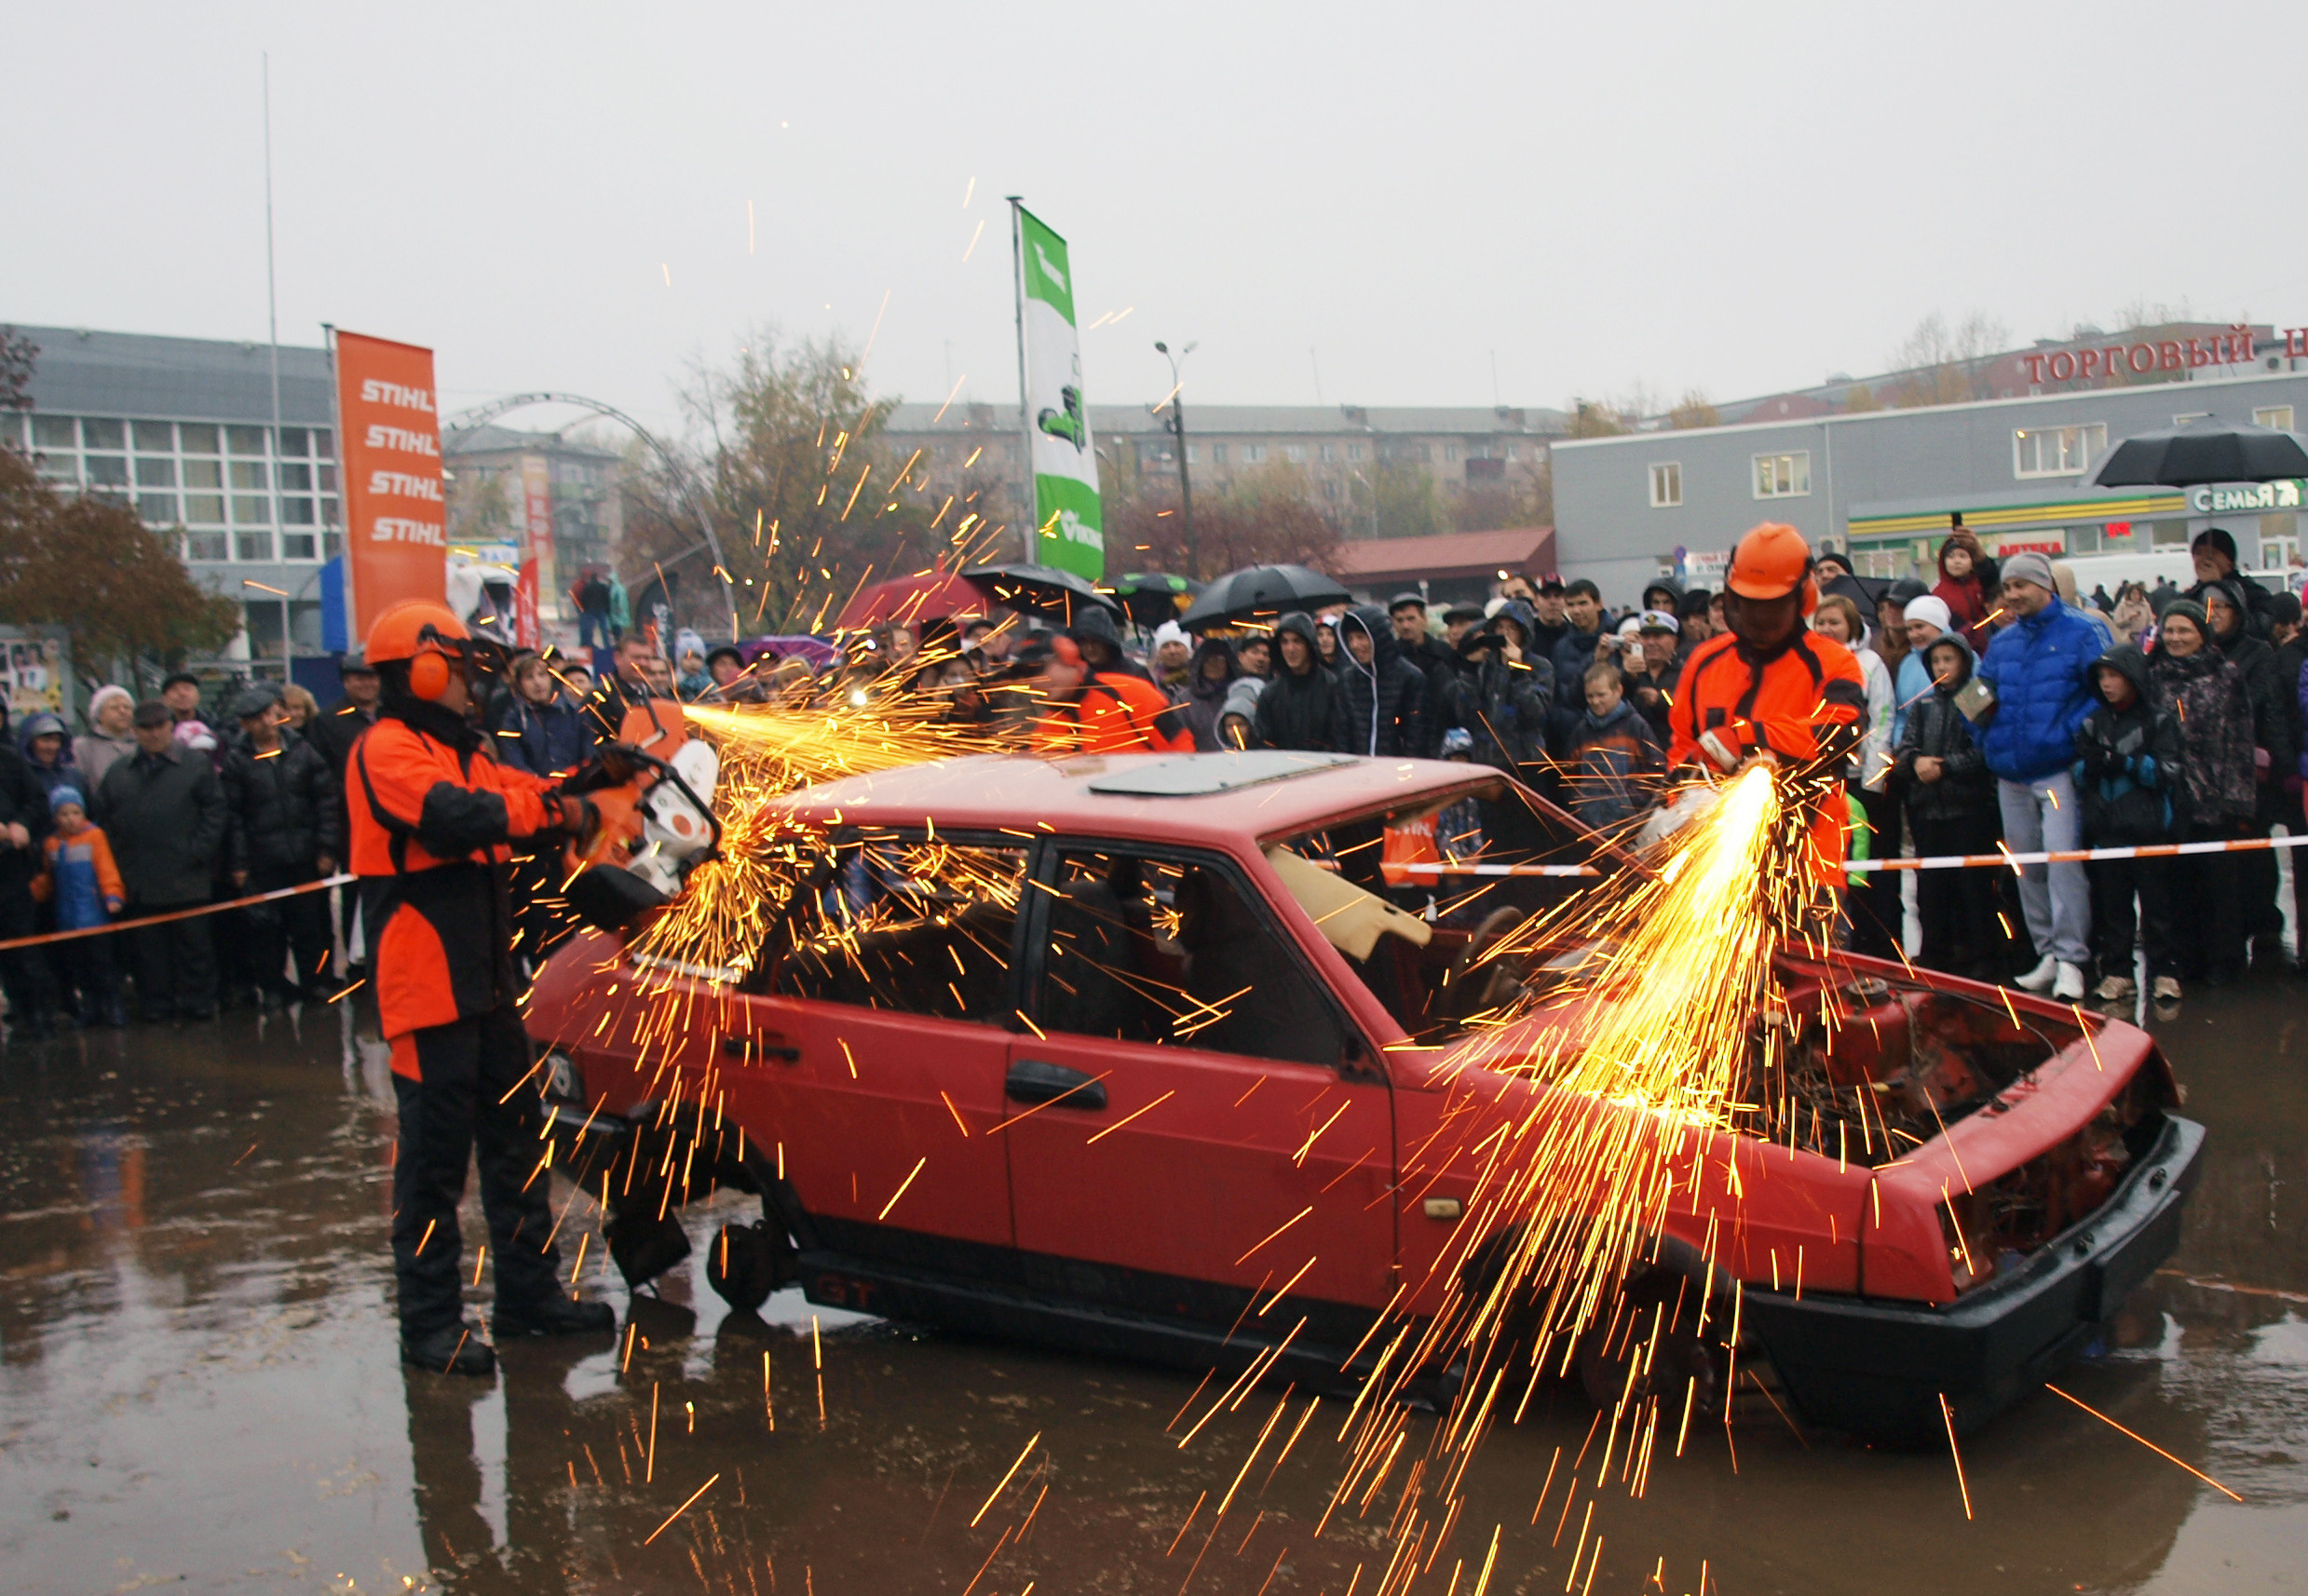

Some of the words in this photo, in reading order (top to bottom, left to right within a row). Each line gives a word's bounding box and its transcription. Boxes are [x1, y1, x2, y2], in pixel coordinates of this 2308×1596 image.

[2024, 323, 2255, 384] ТОРГОВЫЙ
[360, 378, 435, 413] STIHL
[365, 424, 440, 457] STIHL
[369, 470, 444, 502] STIHL
[372, 516, 446, 548] STIHL
[1998, 541, 2062, 557] АПТЕКА
